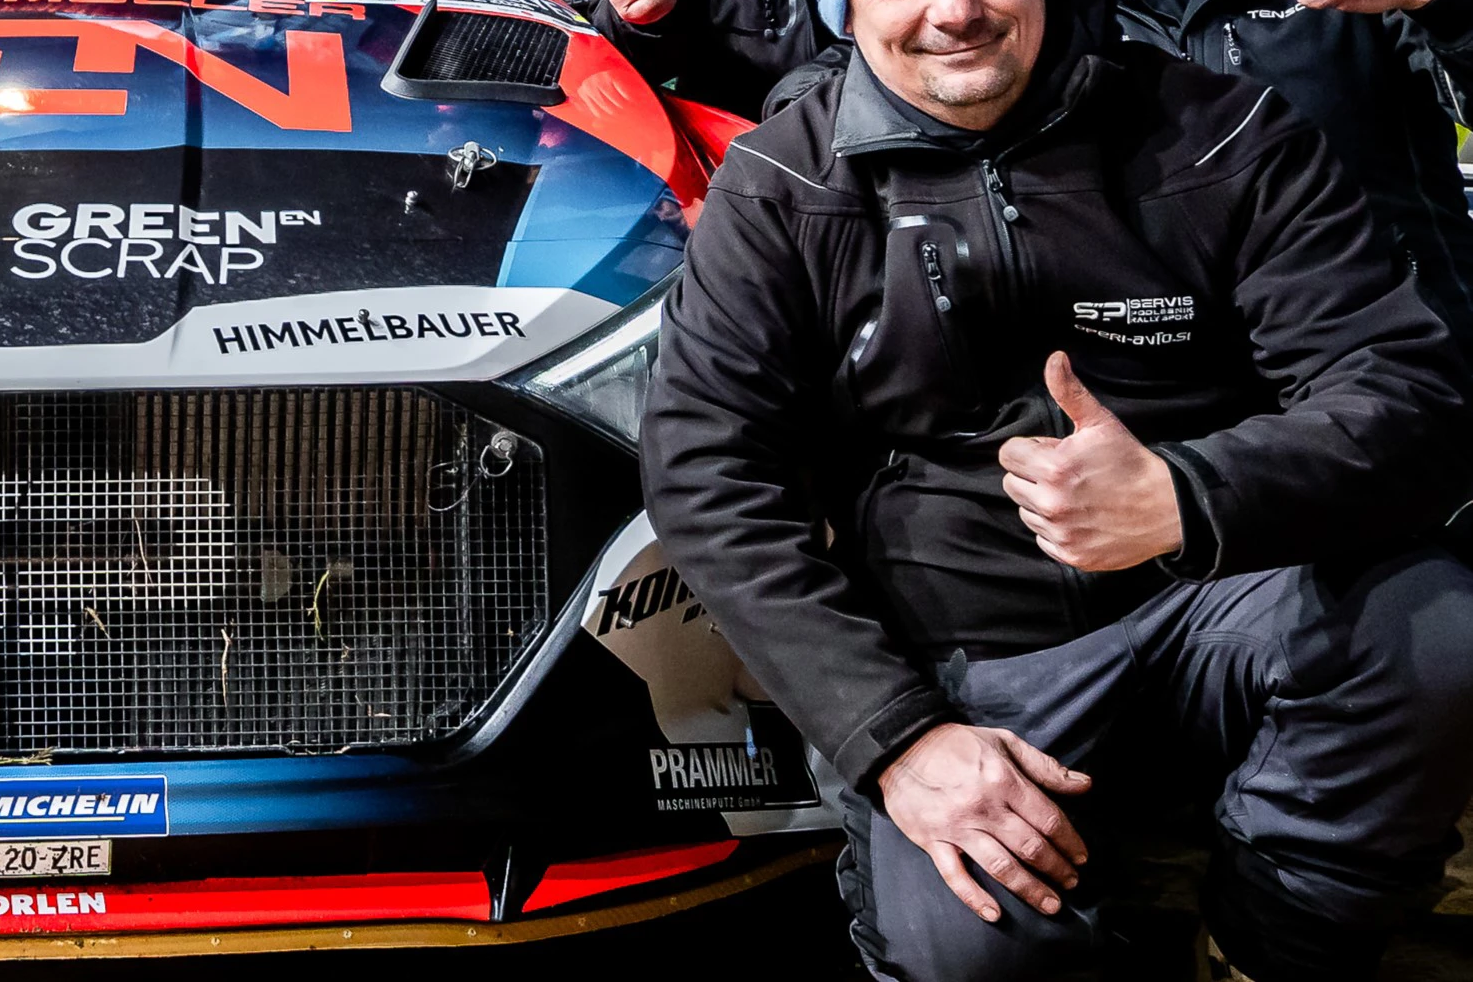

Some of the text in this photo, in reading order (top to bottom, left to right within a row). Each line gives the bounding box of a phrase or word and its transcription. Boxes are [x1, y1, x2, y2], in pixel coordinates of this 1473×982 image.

[11, 202, 277, 245] GREEN
[10, 237, 265, 285] SCRAP
[1130, 296, 1194, 309] SERVIS
[213, 311, 527, 355] HIMMELBAUER
[649, 747, 779, 789] PRAMMER
[657, 796, 734, 811] MASCHINENPUTZ
[4, 844, 101, 872] 20-ZRE
